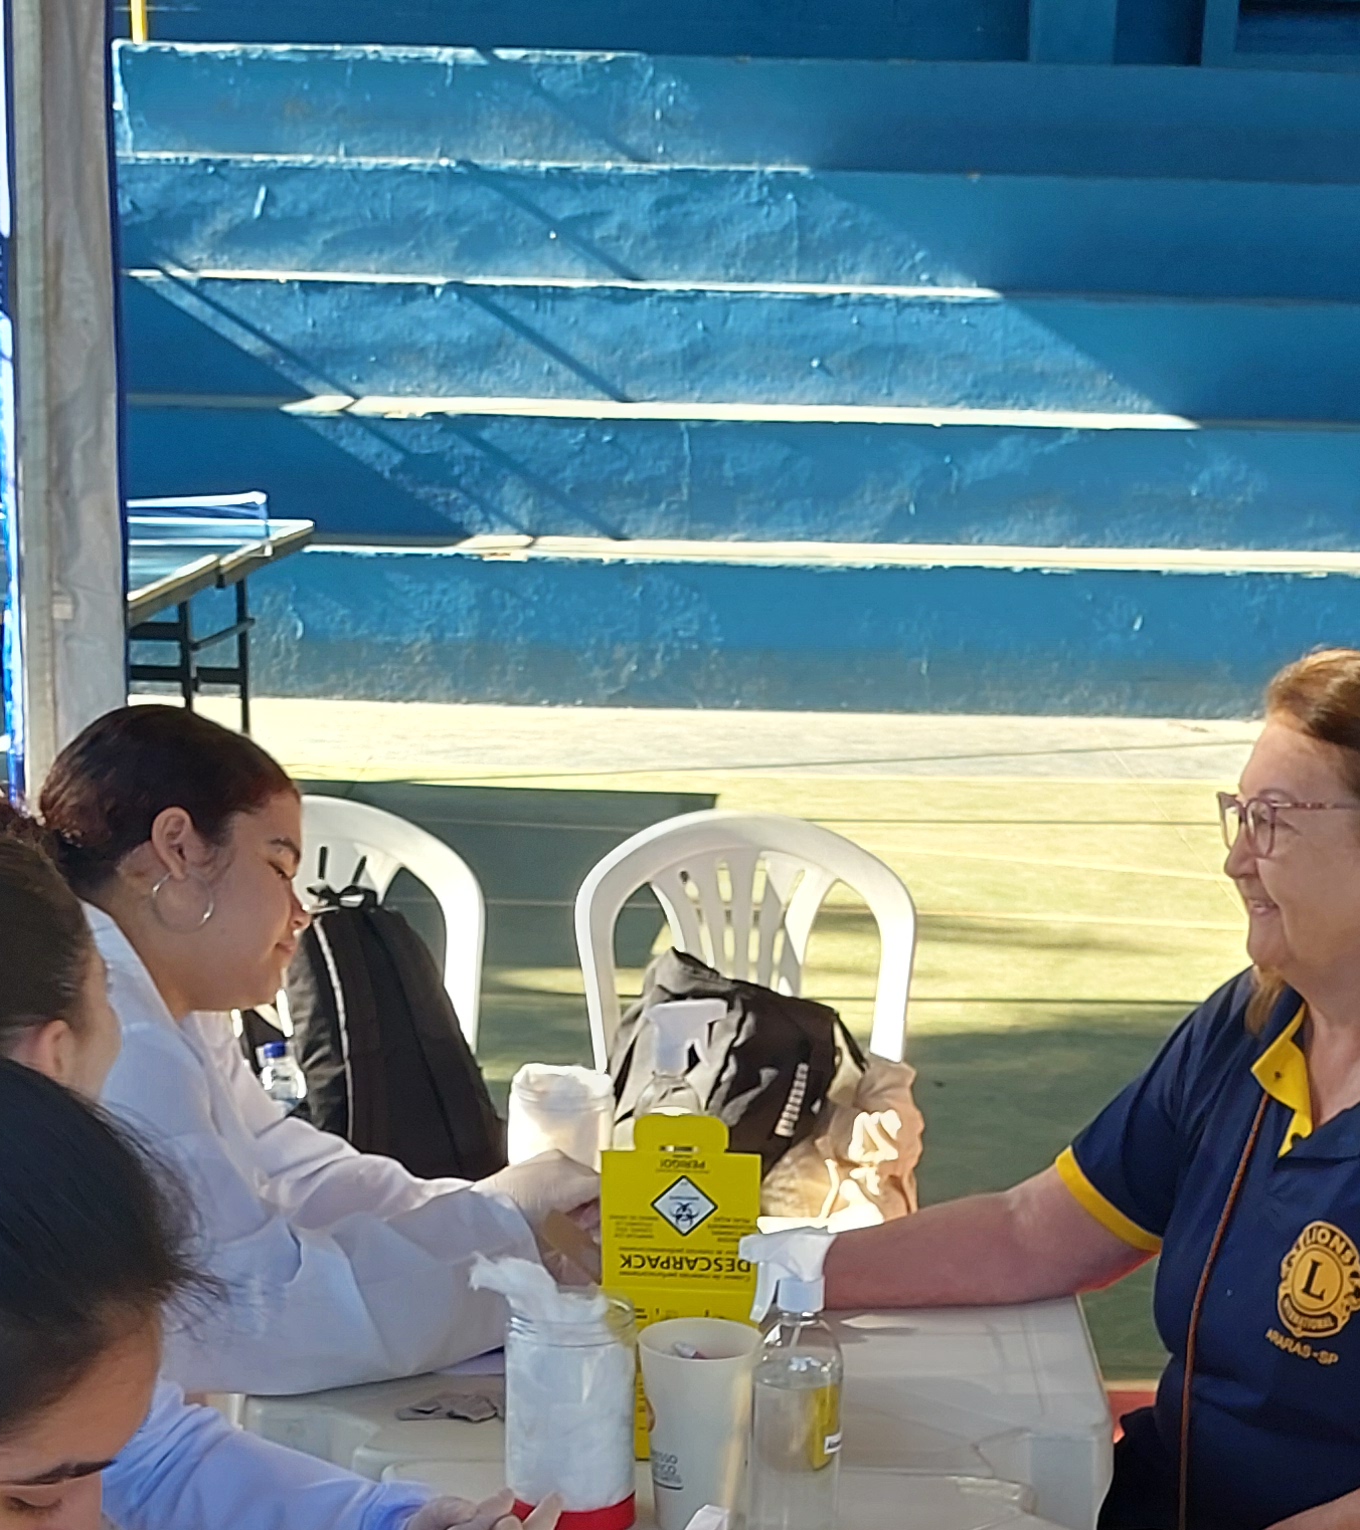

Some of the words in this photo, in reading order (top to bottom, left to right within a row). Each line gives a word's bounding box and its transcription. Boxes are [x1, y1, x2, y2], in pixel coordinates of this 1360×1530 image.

[619, 1253, 751, 1274] DESCARPACK
[1305, 1227, 1355, 1266] LIONS
[1301, 1258, 1326, 1302] L
